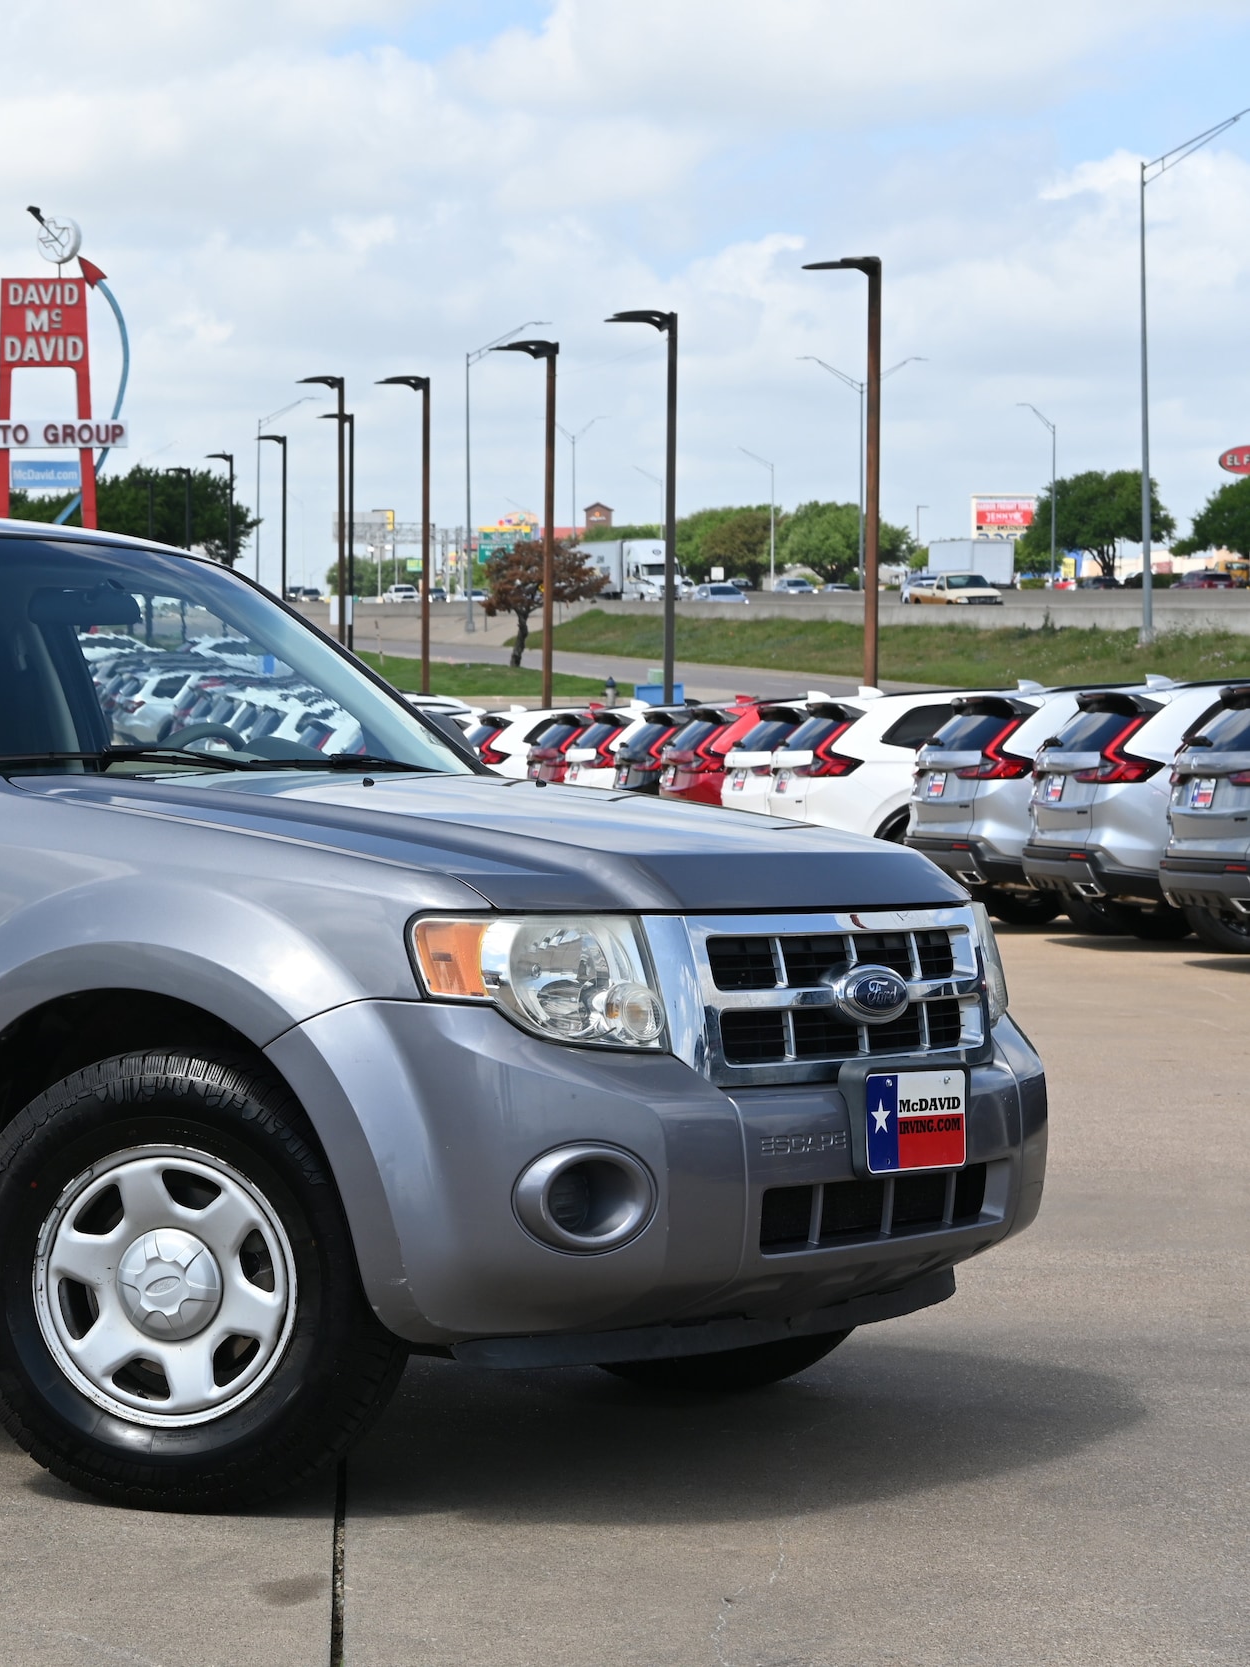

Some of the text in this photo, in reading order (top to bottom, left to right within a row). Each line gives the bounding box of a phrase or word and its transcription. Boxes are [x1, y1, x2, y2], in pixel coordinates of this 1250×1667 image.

[8, 283, 79, 306] DAVID
[4, 335, 84, 362] DAVID
[43, 423, 125, 445] GROUP
[1226, 454, 1241, 467] EL
[13, 468, 78, 480] McDavid.com
[866, 980, 899, 1005] Ford
[899, 1096, 961, 1113] McDAVID
[899, 1117, 961, 1135] IRVING.COM
[761, 1131, 847, 1156] ESCAPE
